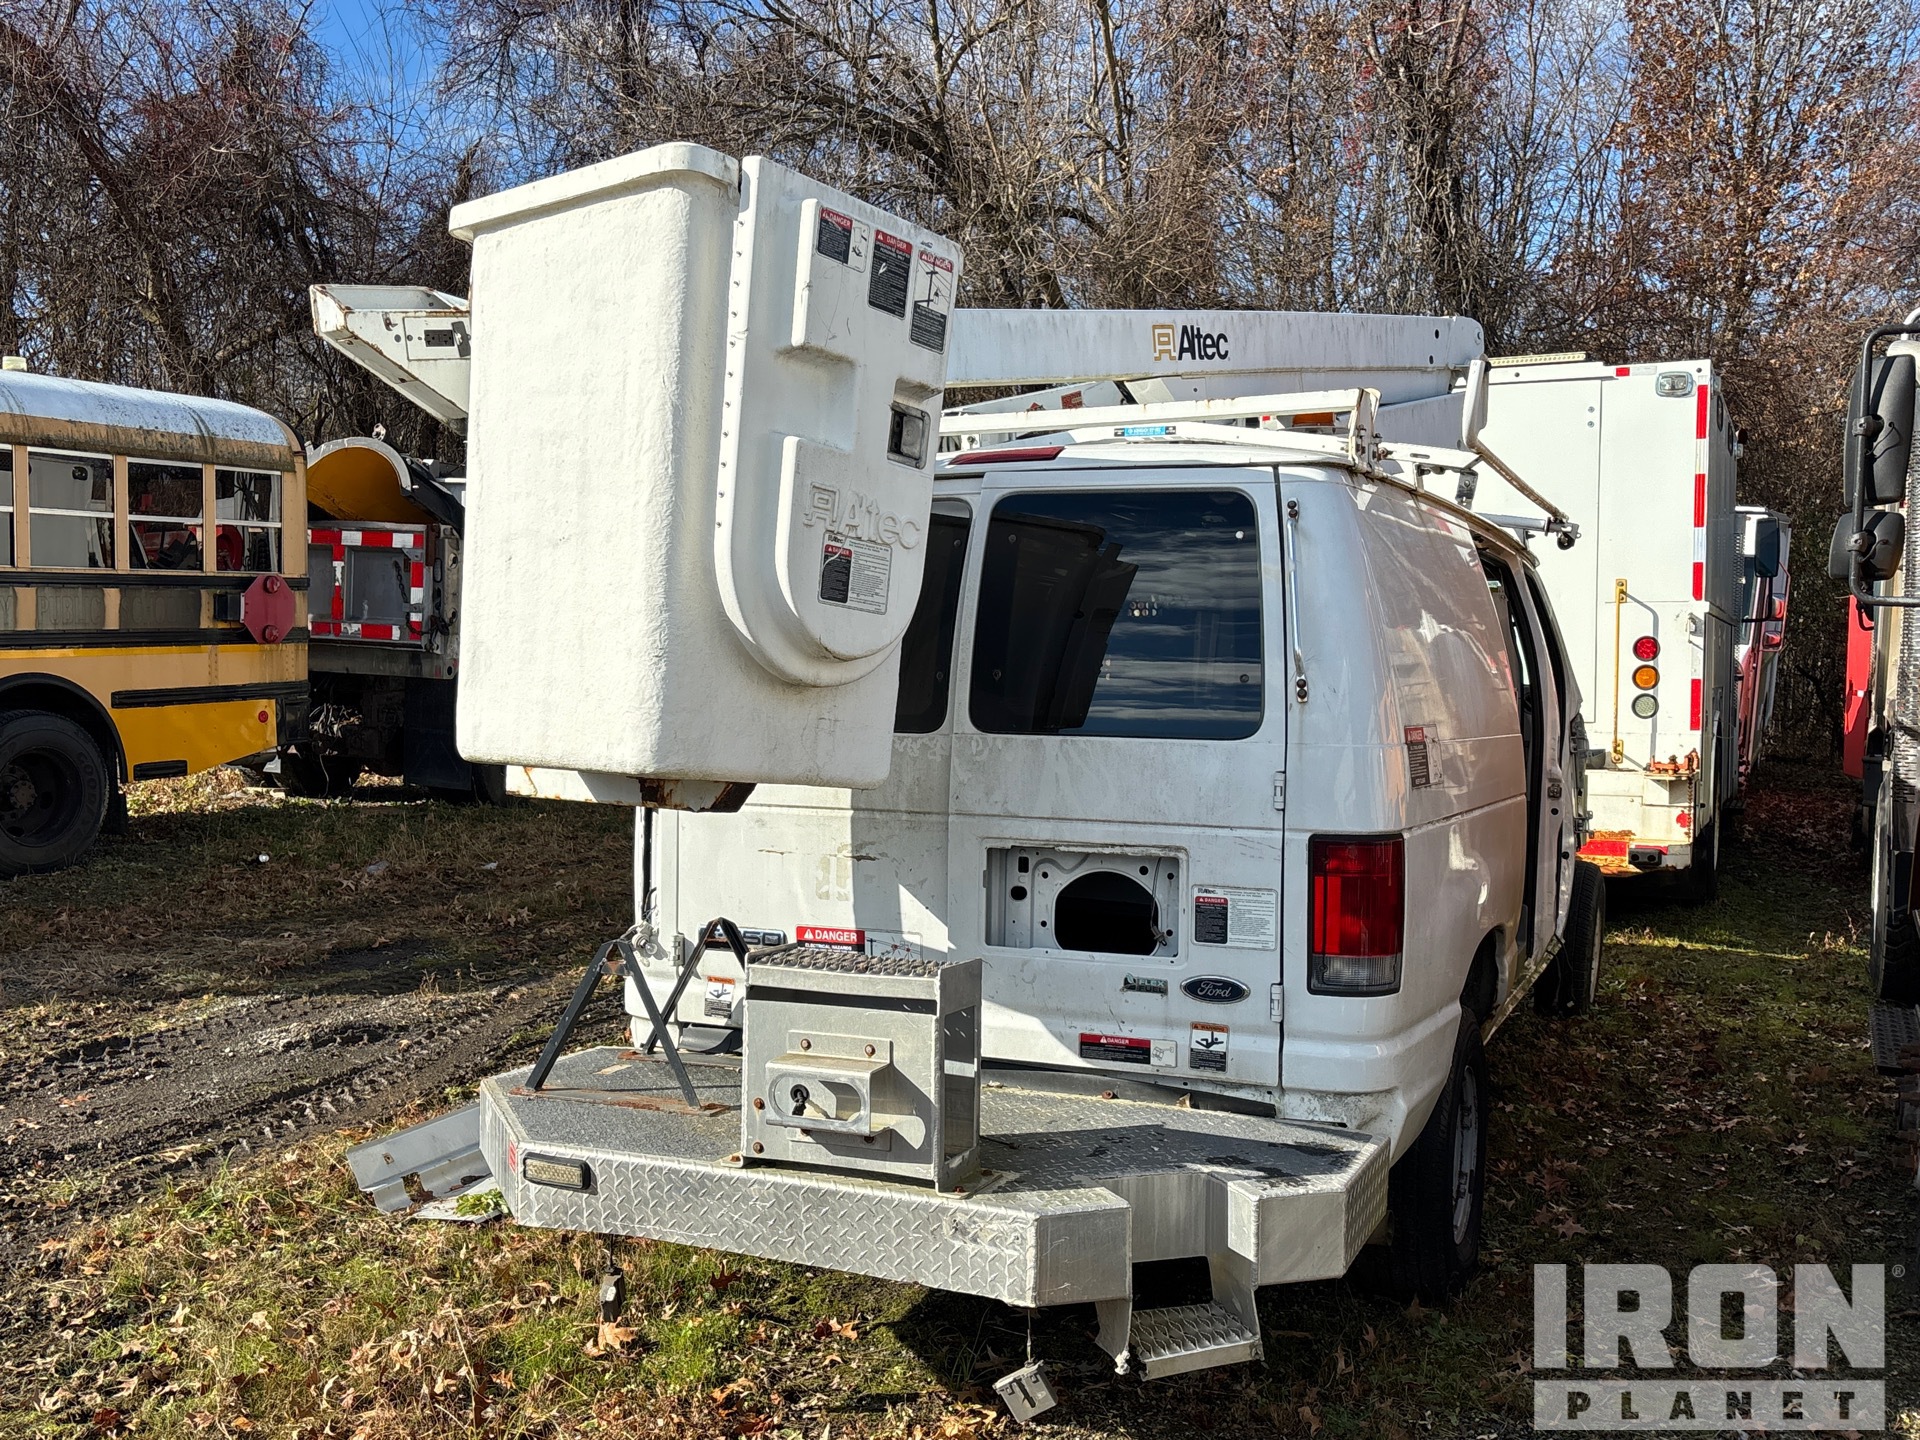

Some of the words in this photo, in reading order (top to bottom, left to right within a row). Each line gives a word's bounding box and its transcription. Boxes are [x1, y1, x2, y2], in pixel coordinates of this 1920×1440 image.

[829, 213, 851, 227] DANGER
[886, 235, 907, 249] DANGER
[1178, 324, 1229, 361] Altec
[841, 490, 920, 550] Altec
[38, 596, 101, 626] PUBLIC
[815, 929, 857, 942] DANGER
[1139, 978, 1165, 987] FLEX
[1197, 980, 1232, 998] Ford
[1106, 1037, 1130, 1045] DANGER
